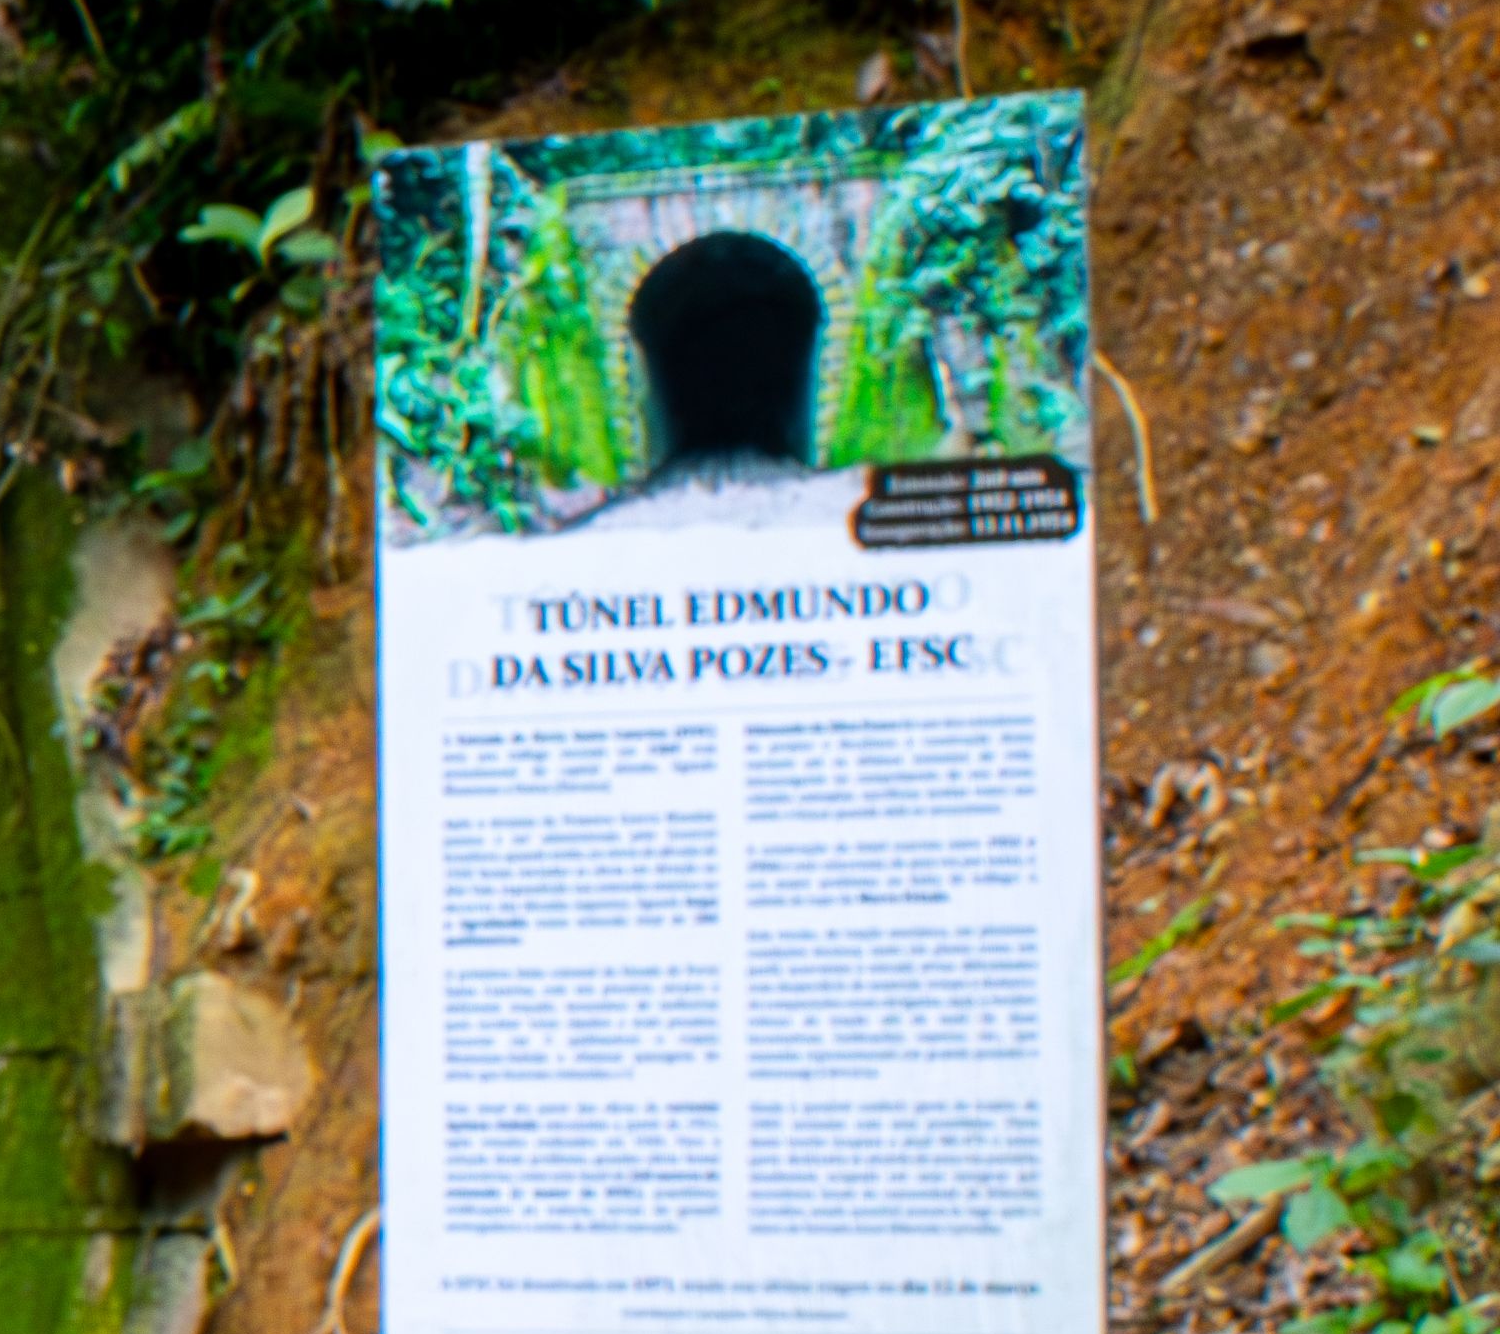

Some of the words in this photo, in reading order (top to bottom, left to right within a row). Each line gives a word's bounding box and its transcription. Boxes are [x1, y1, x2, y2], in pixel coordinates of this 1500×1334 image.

[528, 589, 675, 634] TÚNEL
[685, 579, 931, 626] EDMUNDO
[491, 654, 551, 689] DA
[562, 649, 676, 685] SILVA
[687, 641, 829, 680] POZES
[866, 632, 973, 673] EFSC
